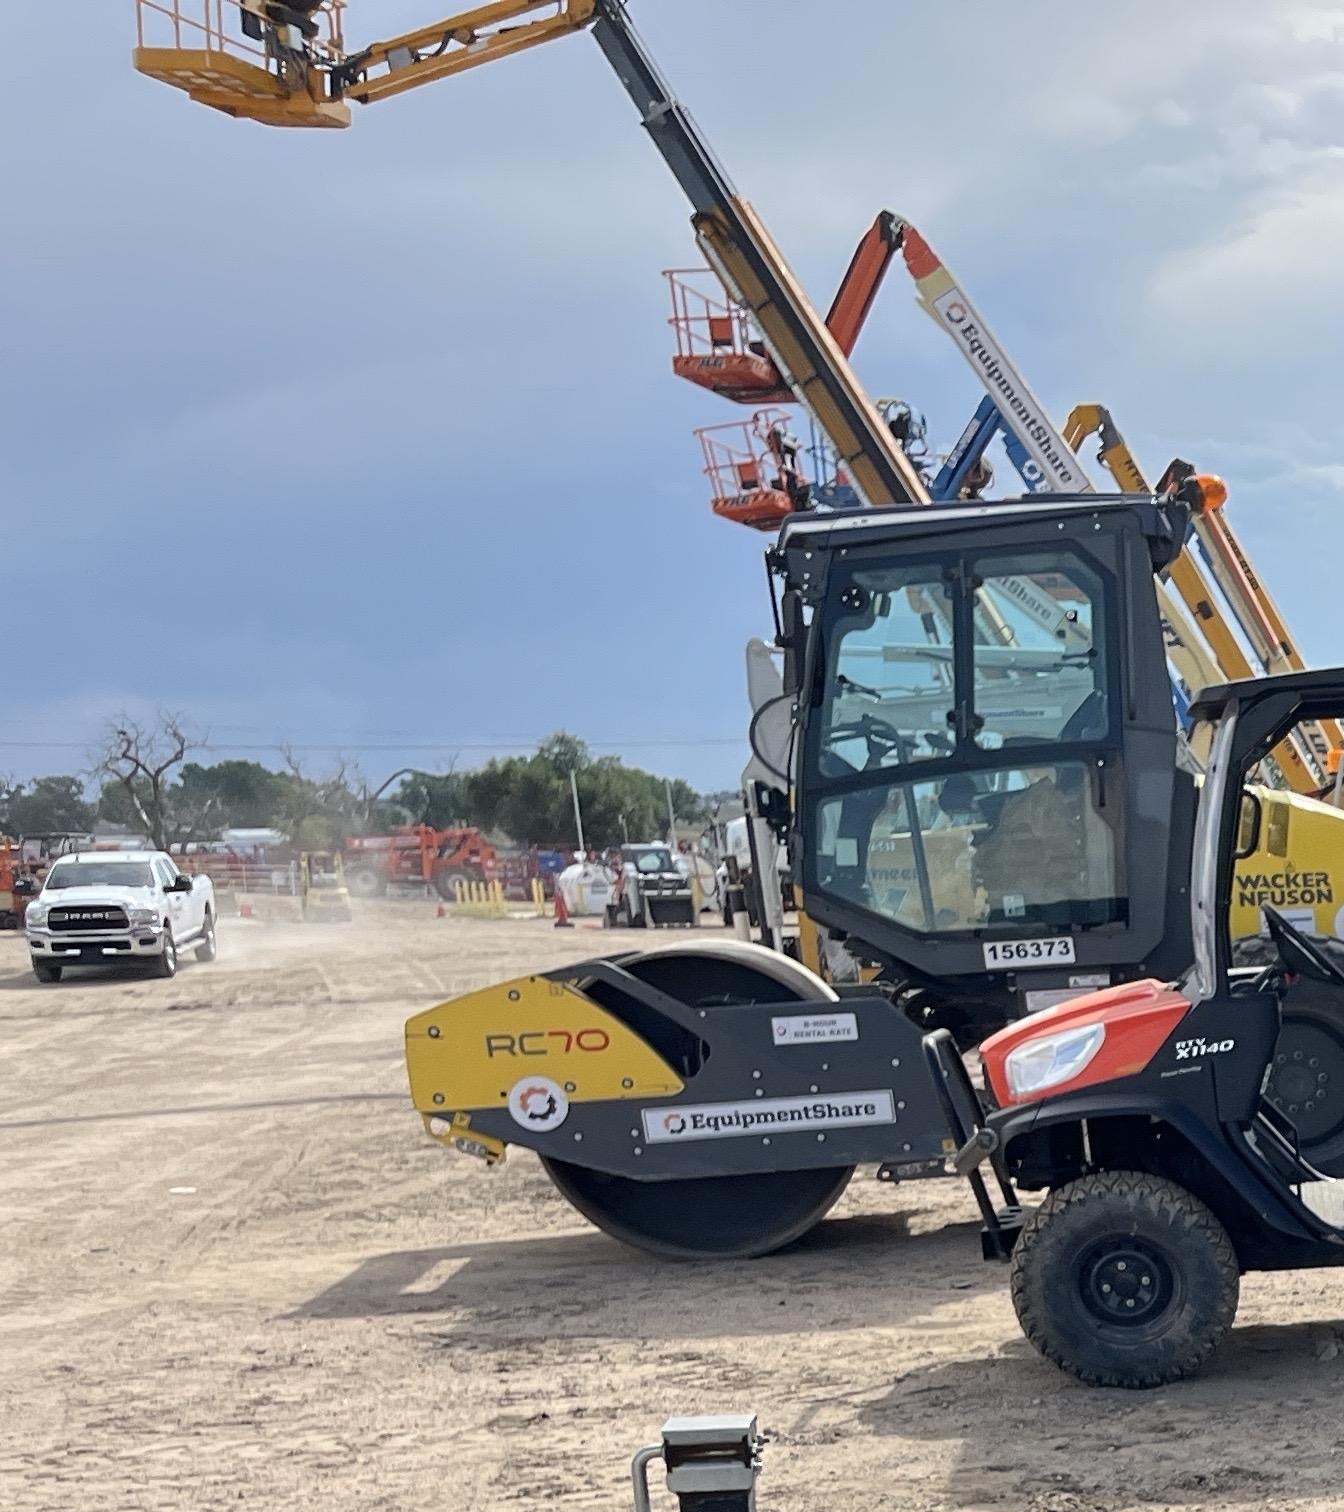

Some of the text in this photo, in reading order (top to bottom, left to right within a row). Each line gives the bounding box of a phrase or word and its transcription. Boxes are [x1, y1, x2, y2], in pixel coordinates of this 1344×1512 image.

[960, 322, 1073, 483] EquipmentShare
[1236, 872, 1331, 890] WACKER
[1239, 889, 1334, 908] NEUSON
[987, 940, 1072, 961] 156373
[486, 1028, 610, 1058] RC70
[691, 1103, 876, 1132] EquipmentShare
